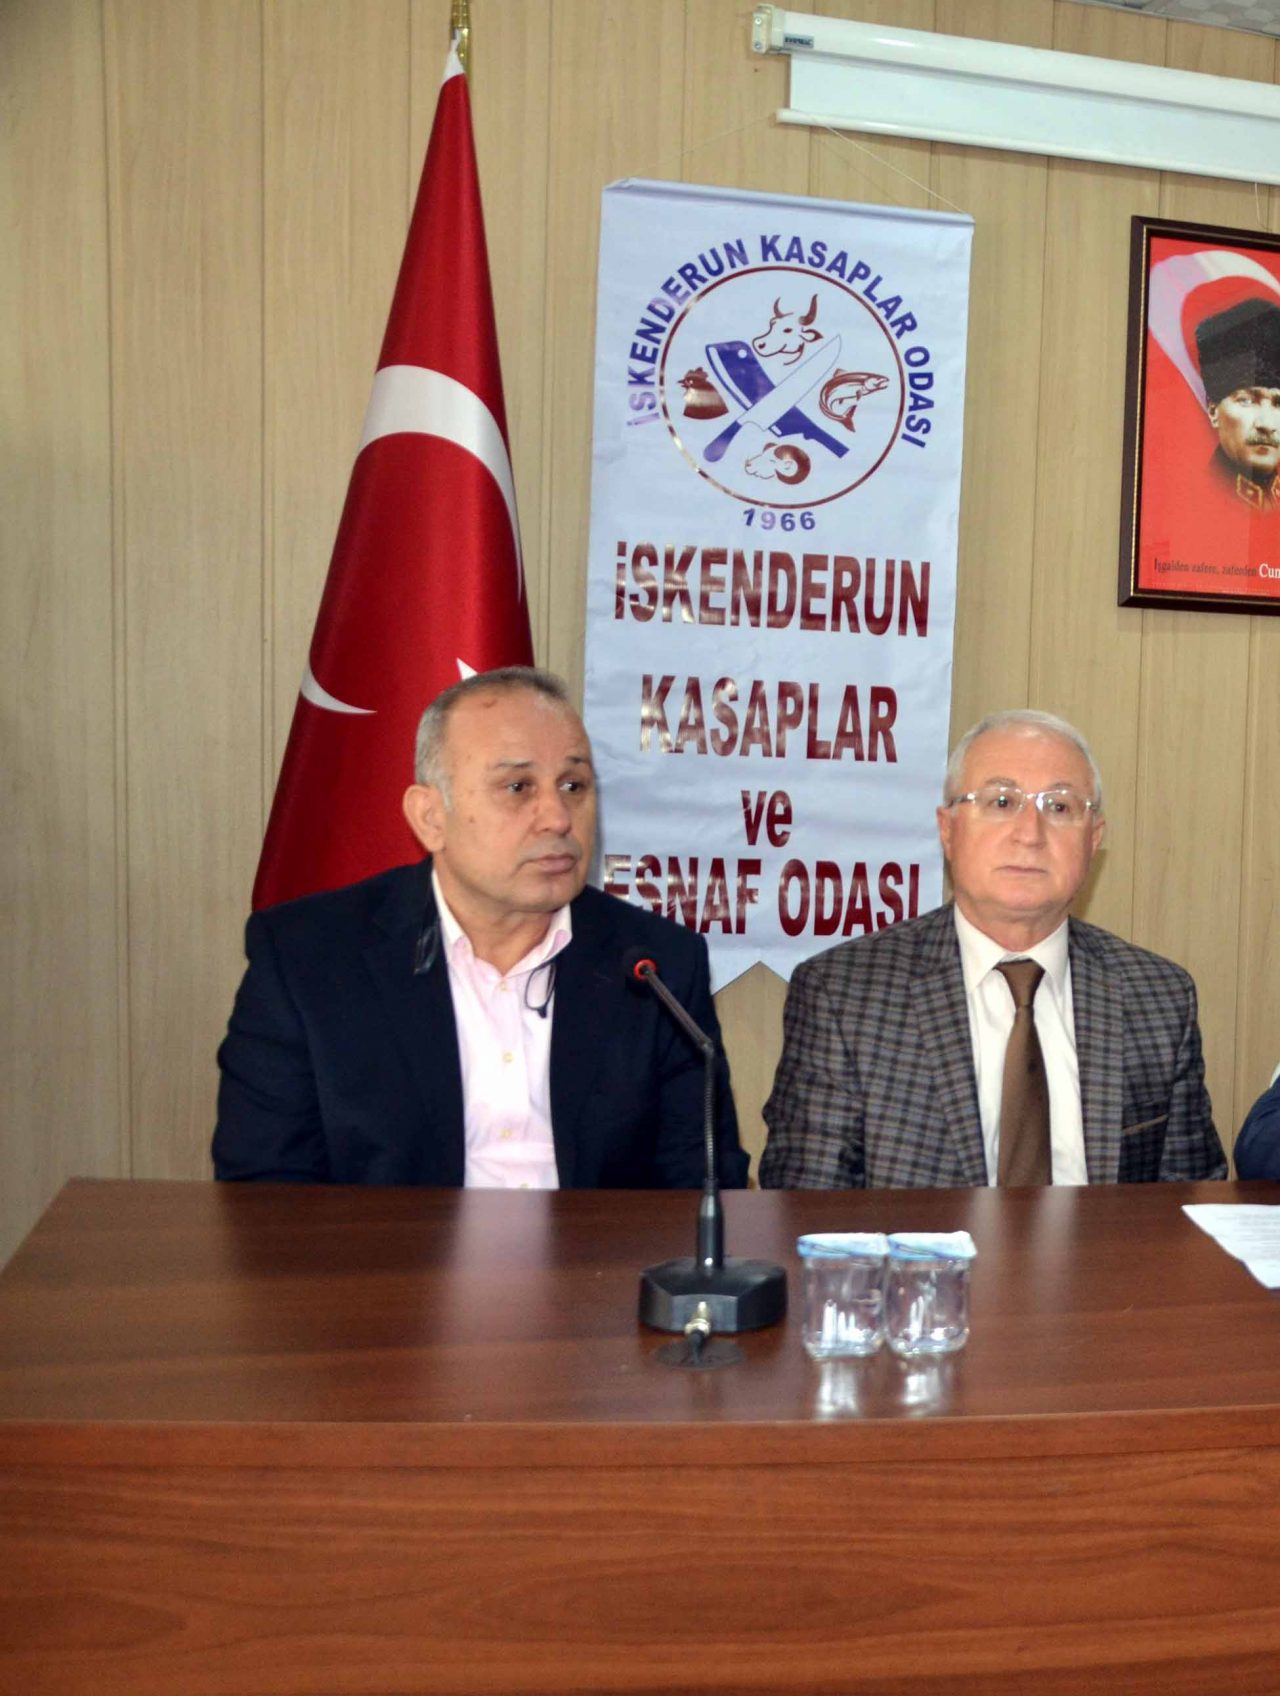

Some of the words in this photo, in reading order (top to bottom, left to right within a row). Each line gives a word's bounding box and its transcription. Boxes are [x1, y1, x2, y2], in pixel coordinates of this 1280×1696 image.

[760, 234, 918, 340] KASAPLAR
[901, 345, 935, 448] ODASI
[743, 508, 816, 532] 1966
[640, 674, 898, 763] KASAPLAR
[741, 790, 793, 848] ve
[604, 854, 762, 935] ESNAF
[778, 858, 920, 937] ODASI
